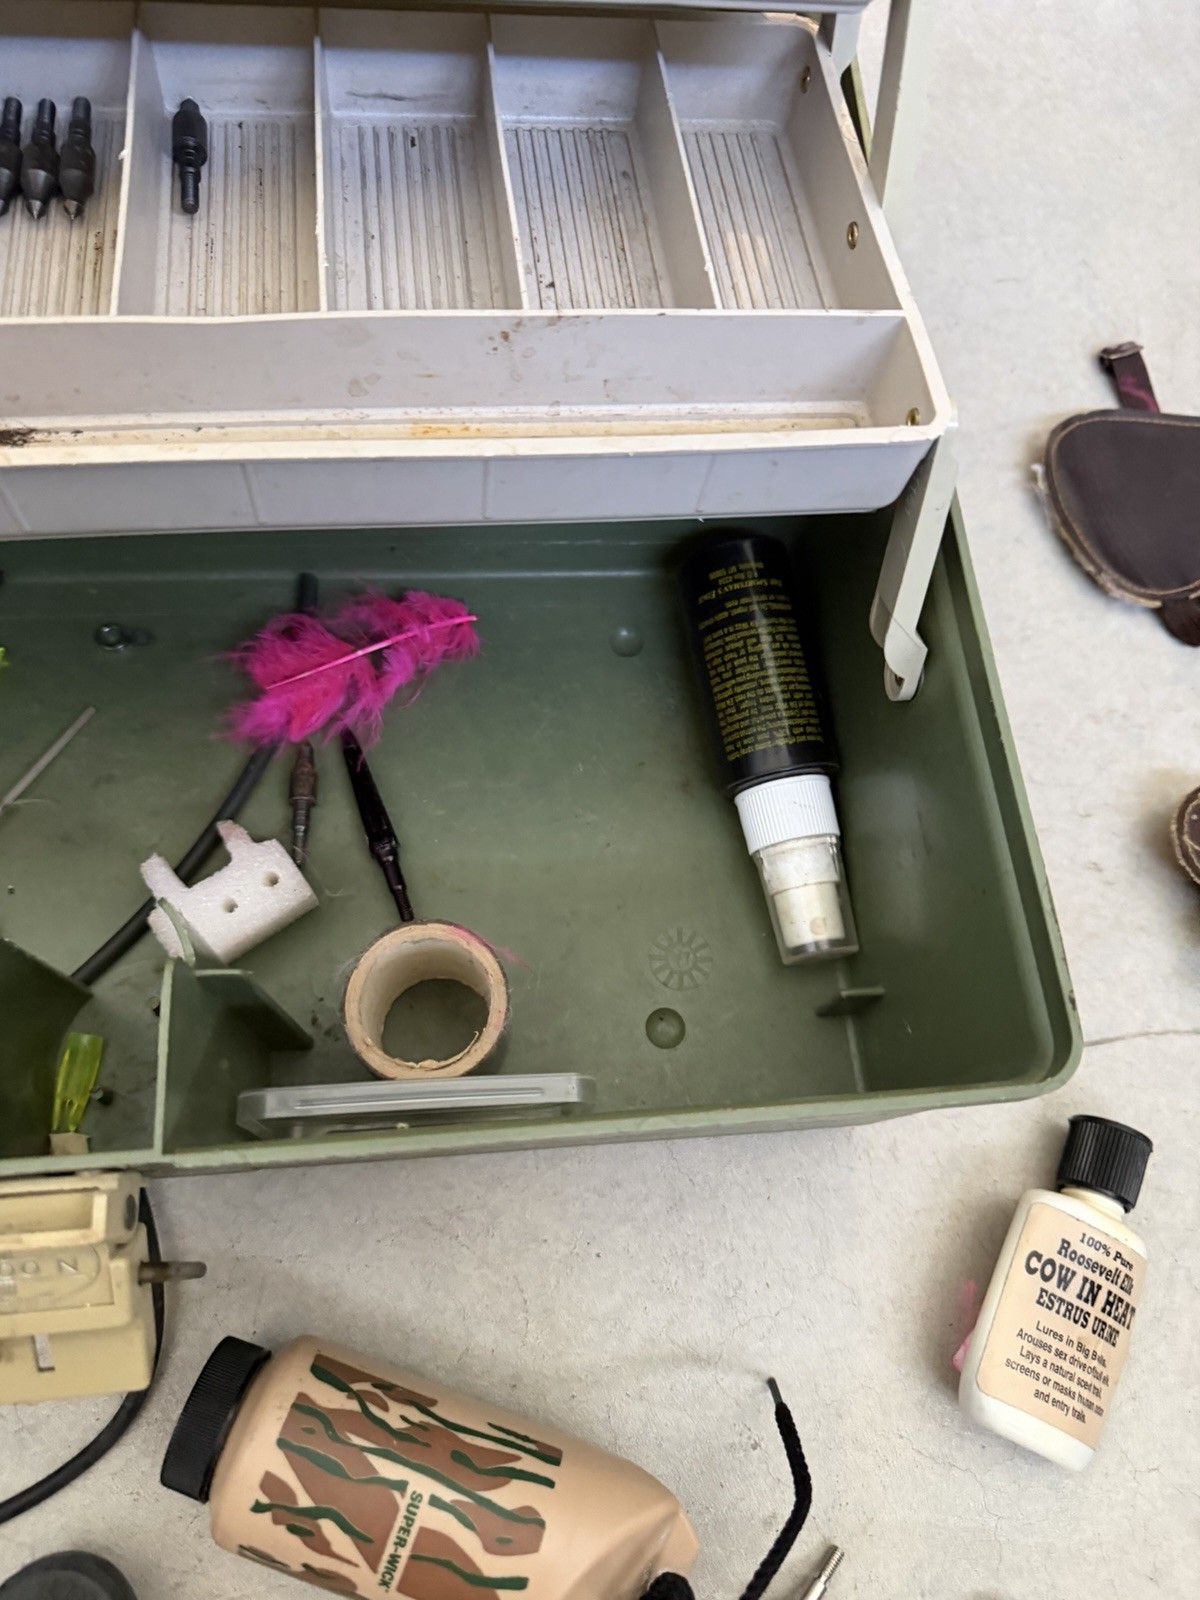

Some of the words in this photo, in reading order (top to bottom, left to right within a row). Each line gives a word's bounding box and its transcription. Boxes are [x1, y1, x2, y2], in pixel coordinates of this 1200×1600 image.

[1057, 1238, 1120, 1286] Roosevelt
[1120, 1270, 1135, 1296] Elk
[1080, 1233, 1111, 1257] 100%
[1113, 1252, 1133, 1271] Pure
[1025, 1250, 1077, 1292] COW
[1076, 1276, 1101, 1306] IN
[1101, 1287, 1136, 1330] HEAT
[1036, 1287, 1092, 1329] ESTRUS
[1091, 1315, 1120, 1347] URINE
[1017, 1328, 1052, 1354] Arouses
[1054, 1347, 1068, 1361] sex
[1068, 1352, 1088, 1371] drive
[1036, 1320, 1064, 1342] Lures
[1066, 1333, 1074, 1347] in
[1077, 1342, 1090, 1359] Big
[1005, 1358, 1040, 1381] screens
[1042, 1377, 1050, 1386] or
[1053, 1378, 1076, 1398] masks
[1020, 1346, 1041, 1366] Lays
[1042, 1359, 1047, 1368] a
[1049, 1362, 1076, 1381] natural
[1034, 1388, 1050, 1404] and
[1051, 1398, 1071, 1419] entry
[378, 1490, 422, 1590] SUPER-WICK
